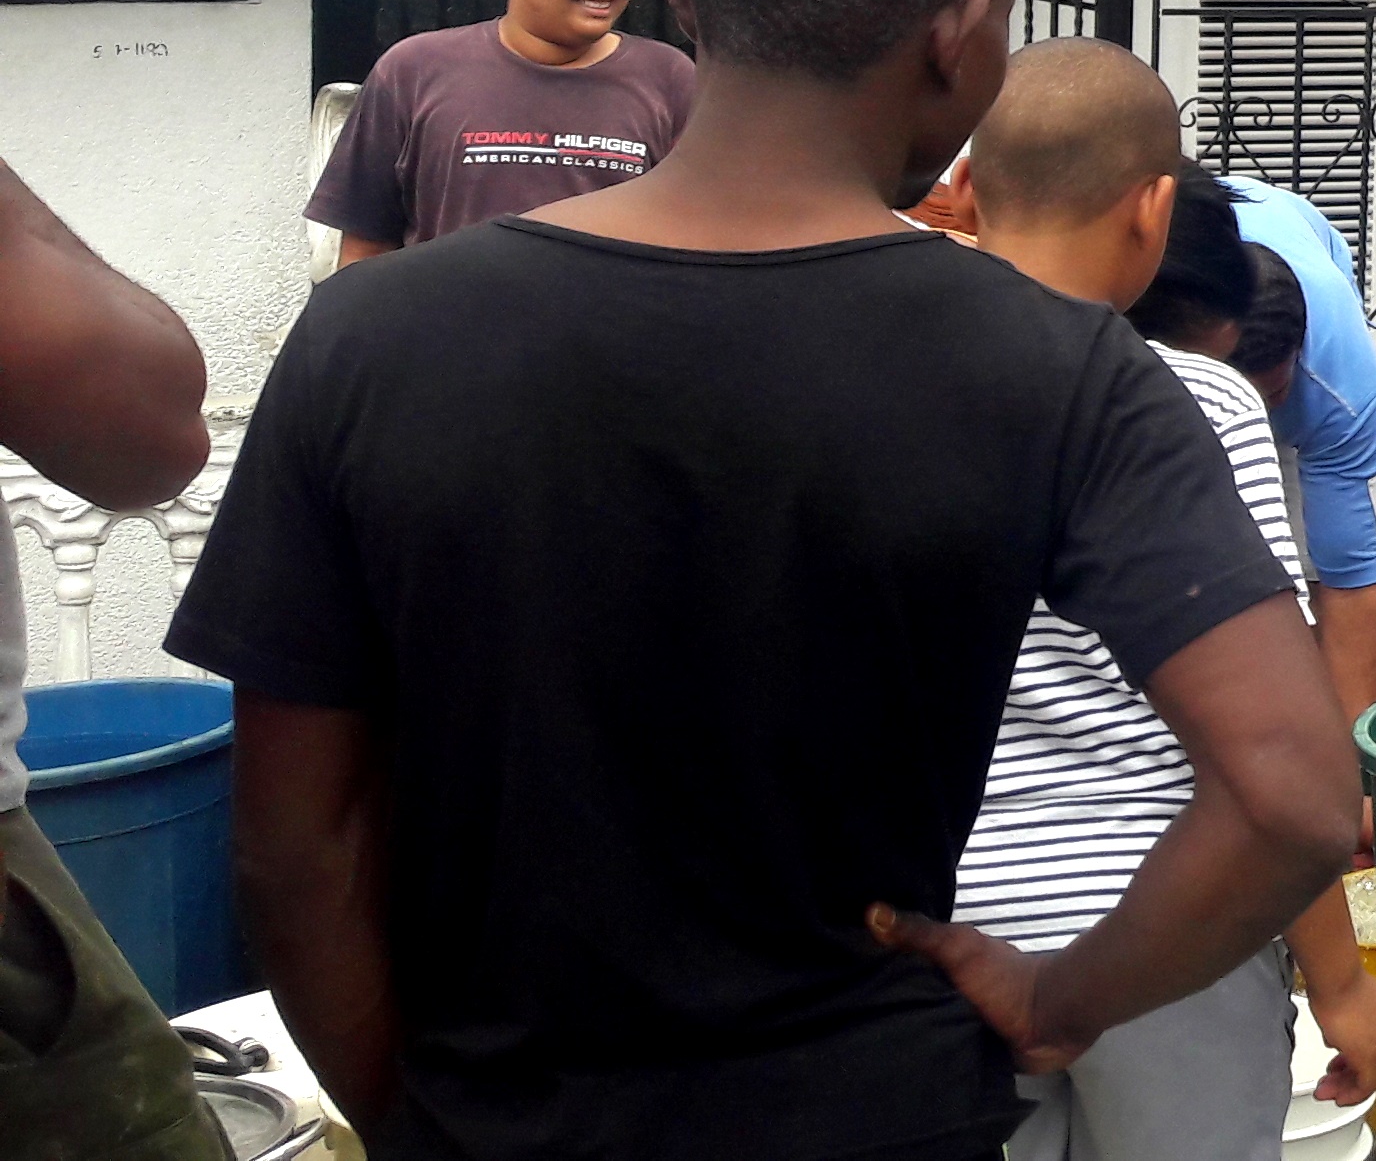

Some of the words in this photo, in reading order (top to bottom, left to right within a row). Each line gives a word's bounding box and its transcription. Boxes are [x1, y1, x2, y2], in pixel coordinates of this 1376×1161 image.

[461, 132, 549, 145] TOMMY
[554, 134, 647, 156] HILFIGER
[462, 154, 557, 165] AMERICAN
[562, 157, 644, 174] CLASSICS
